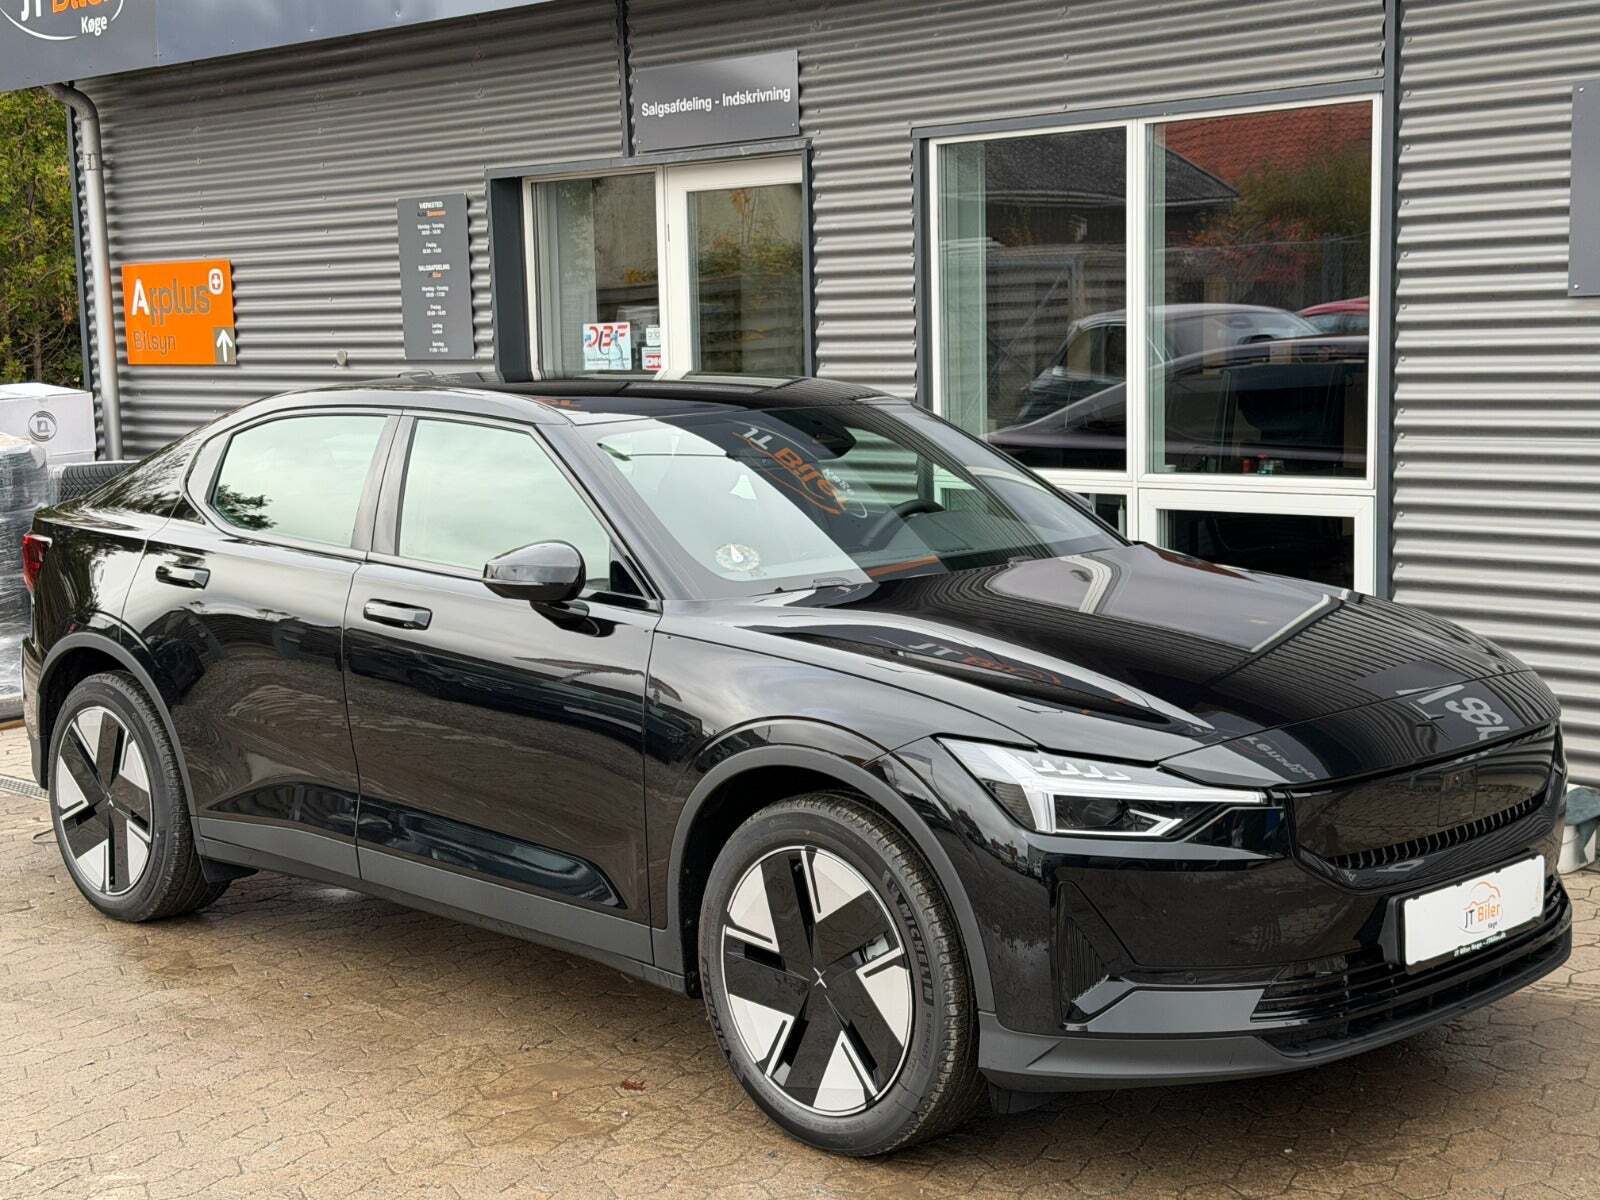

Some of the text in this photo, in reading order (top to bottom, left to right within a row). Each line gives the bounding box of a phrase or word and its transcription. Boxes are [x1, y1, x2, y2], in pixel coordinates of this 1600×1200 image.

[81, 16, 108, 36] Køge
[641, 96, 712, 117] Salgsafdeling
[722, 86, 791, 107] Indskrivning
[133, 330, 176, 356] Bilsyn
[1465, 903, 1501, 929] JT Biler
